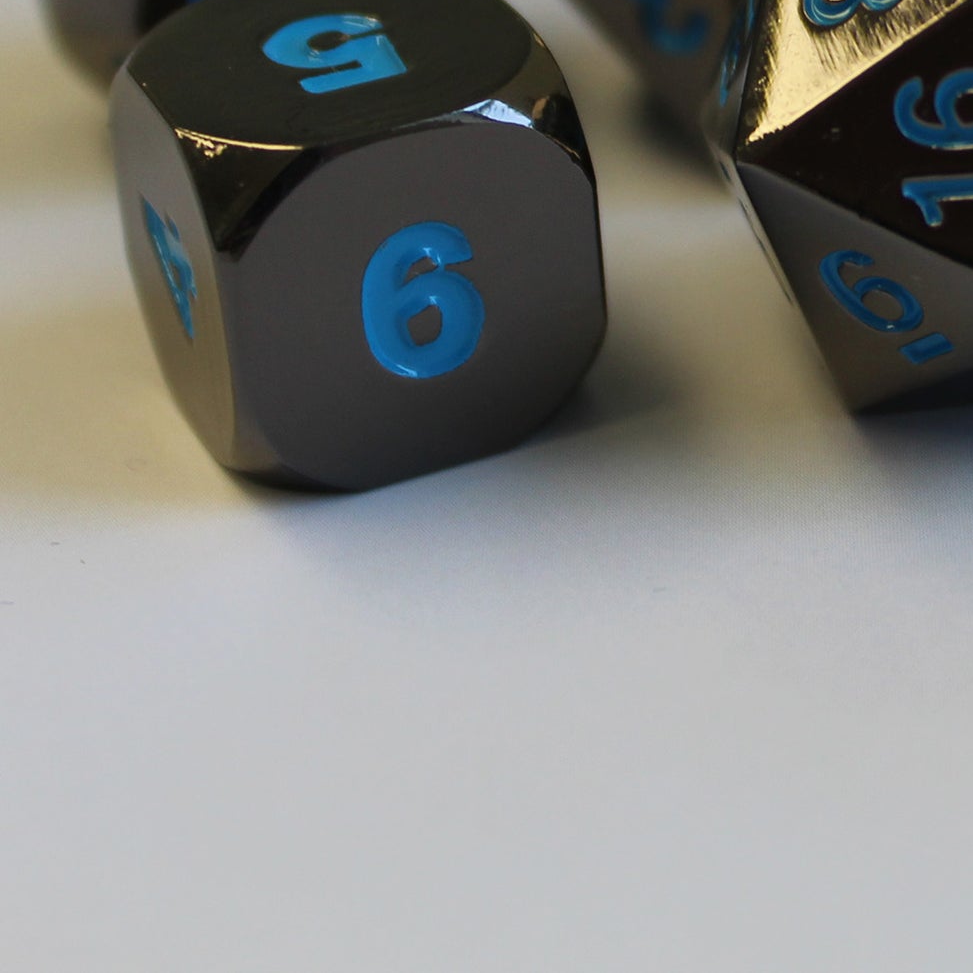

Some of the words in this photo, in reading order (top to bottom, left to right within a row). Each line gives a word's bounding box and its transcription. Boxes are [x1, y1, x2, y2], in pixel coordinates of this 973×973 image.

[261, 13, 408, 95] 5
[140, 193, 197, 339] 4
[360, 220, 487, 381] 6
